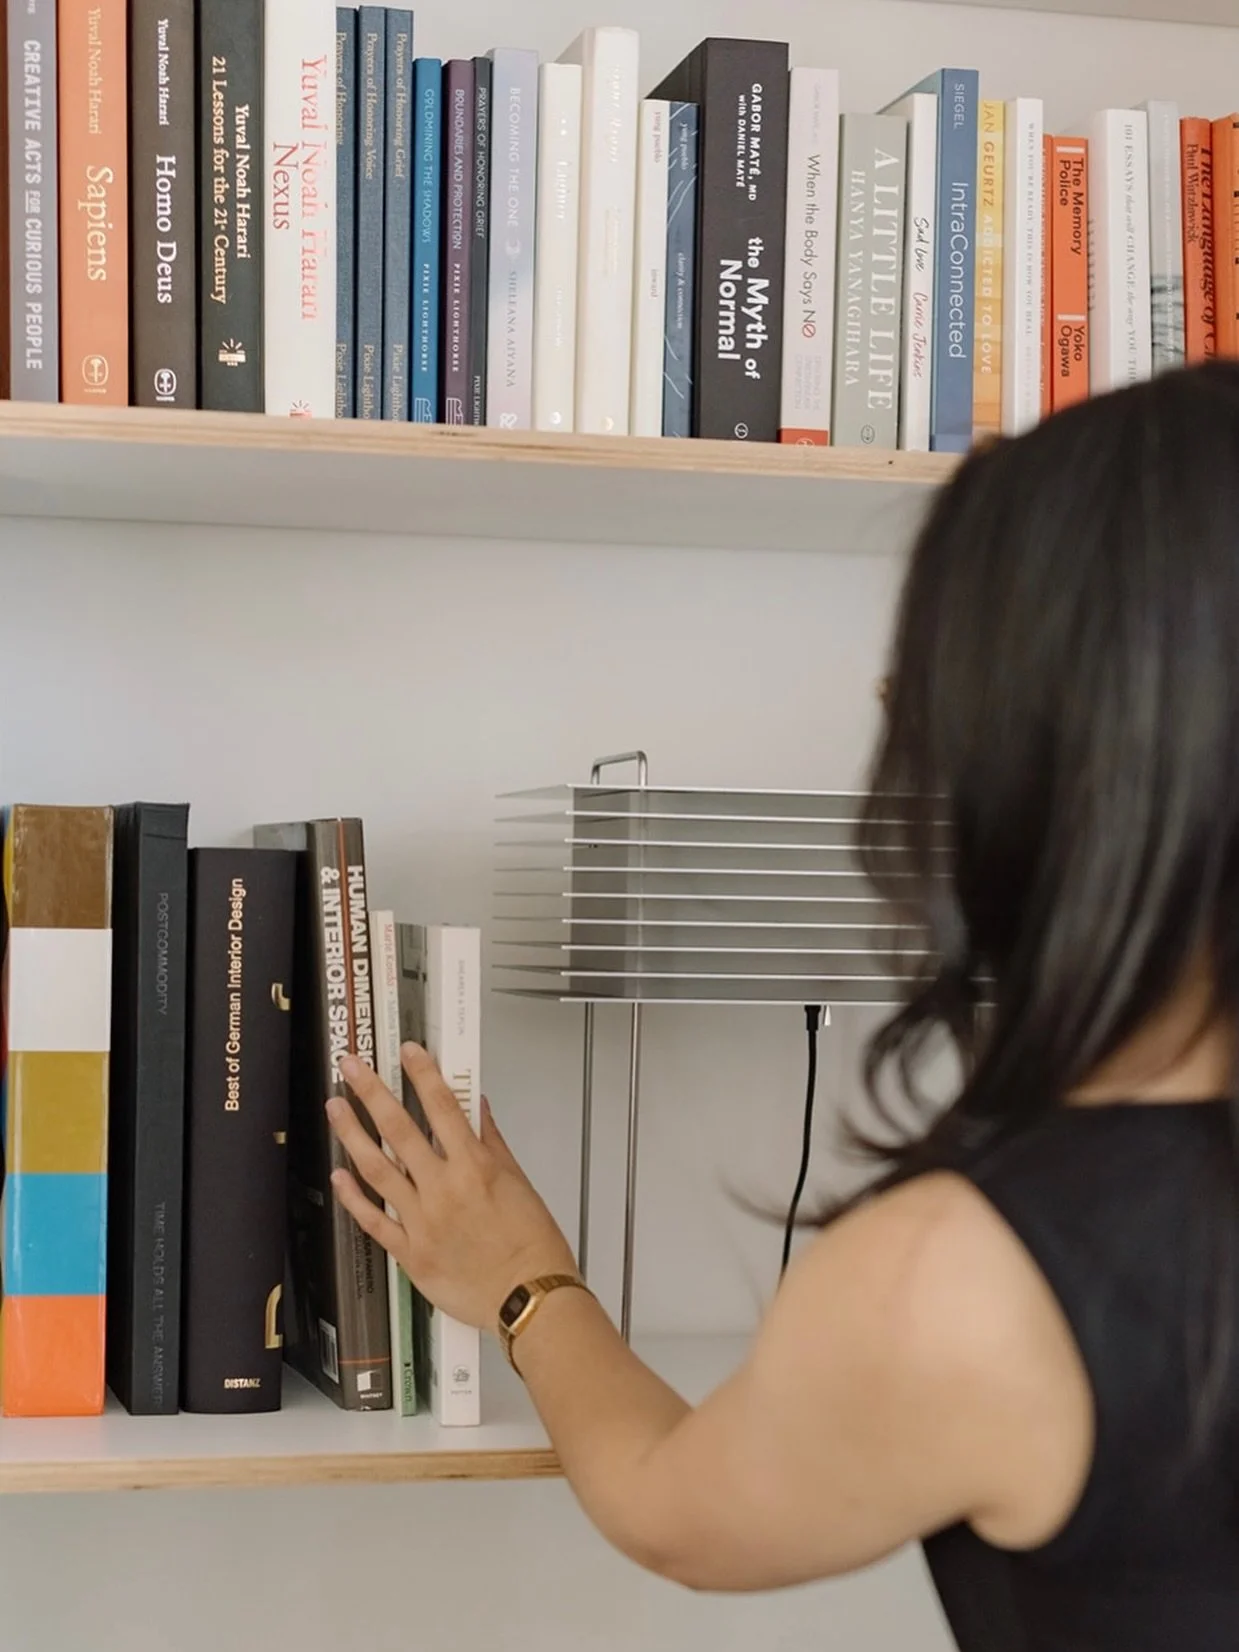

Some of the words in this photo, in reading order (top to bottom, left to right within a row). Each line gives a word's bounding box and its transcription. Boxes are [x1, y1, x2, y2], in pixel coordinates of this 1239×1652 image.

[88, 8, 101, 45] Yuval
[157, 19, 169, 51] Yuval
[88, 49, 102, 86] Noah
[157, 53, 169, 85] Noah
[211, 56, 226, 74] 21
[365, 32, 378, 75] Prayers
[395, 33, 408, 75] Prayers
[24, 40, 41, 130] CREATIVE
[302, 54, 328, 130] Yuval
[366, 78, 378, 90] of
[396, 78, 408, 90] of
[738, 94, 747, 116] with
[88, 89, 103, 134] Harari
[158, 87, 170, 126] Harari
[212, 80, 227, 145] Lessons
[235, 104, 251, 150] Yuval
[364, 92, 377, 146] Honoring
[394, 92, 407, 146] Honoring
[423, 89, 435, 162] GOLDMINING
[454, 89, 465, 154] BOUNDARIES
[476, 87, 486, 131] PRAYERS
[508, 87, 521, 162] BECOMING
[750, 83, 762, 132] GABOR
[953, 83, 965, 130] SIEGEL
[982, 103, 994, 134] JAN
[476, 134, 486, 148] OF
[680, 122, 689, 142] yung
[736, 119, 747, 156] DANIEL
[1124, 124, 1133, 140] 101
[25, 138, 41, 184] ACTS
[213, 149, 230, 173] for
[236, 153, 251, 198] Noah
[365, 150, 377, 180] Voice
[395, 150, 406, 178] Grief
[423, 166, 434, 186] THE
[453, 157, 464, 182] AND
[680, 144, 690, 170] pueblo
[736, 159, 746, 188] MATÉ
[748, 136, 761, 180] MATÉ,
[806, 154, 821, 198] When
[874, 148, 900, 169] A
[983, 140, 995, 208] GEURTZ
[1072, 158, 1084, 187] The
[1124, 145, 1135, 192] ESSAYS
[1186, 144, 1199, 170] Paul
[156, 154, 176, 232] Homo
[213, 177, 230, 204] the
[272, 142, 299, 230] Nexus
[302, 140, 328, 218] Noah
[476, 152, 486, 206] HONORING
[508, 168, 520, 192] THE
[748, 184, 757, 201] MD
[1060, 160, 1072, 207] Police
[25, 190, 41, 213] FOR
[422, 190, 432, 243] SHADOWS
[452, 184, 464, 250] PROTECTION
[507, 196, 519, 227] ONE
[804, 203, 820, 225] the
[849, 170, 866, 241] HANYA
[1186, 173, 1200, 244] Watzlawick
[78, 165, 114, 281] Sapiens
[236, 202, 252, 259] Harari
[475, 210, 485, 238] GRIEF
[913, 217, 930, 244] Sad
[1070, 192, 1084, 256] Memory
[25, 218, 42, 294] CURIOUS
[210, 234, 229, 304] Century
[676, 252, 686, 277] clarity
[747, 236, 764, 269] the
[800, 229, 819, 267] Body
[870, 184, 899, 316] LITTLE
[914, 248, 928, 272] Love
[949, 180, 970, 358] IntraConnected
[982, 215, 993, 297] ADDICTED
[1126, 236, 1136, 289] CHANGE
[156, 240, 177, 304] Deus
[301, 229, 328, 320] Harari
[422, 264, 430, 294] PIXIE
[453, 264, 461, 294] PIXIE
[678, 278, 686, 287] &
[798, 271, 818, 305] Says
[717, 258, 743, 361] Normal
[740, 278, 770, 350] Myth
[844, 250, 864, 387] YANAGIHARA
[982, 304, 992, 326] TO
[25, 302, 42, 369] PEOPLE
[420, 300, 430, 372] LIGHTHORSE
[452, 300, 460, 372] LIGHTHORSE
[912, 333, 928, 378] Jenkins
[981, 333, 992, 374] LOVE
[1058, 325, 1072, 378] Ogawa
[1074, 325, 1085, 362] Yoko
[1128, 330, 1136, 354] YOU
[363, 344, 375, 372] Pixie
[392, 344, 403, 372] Pixie
[744, 358, 760, 380] of
[867, 328, 895, 410] LIFE
[320, 866, 340, 886] &
[228, 878, 247, 931] Design
[347, 865, 368, 953] HUMAN
[156, 892, 169, 1016] POSTCOMMODITY
[227, 934, 243, 989] Interior
[322, 888, 346, 1000] INTERIOR
[386, 954, 396, 987] Kondo
[226, 992, 242, 1054] German
[225, 1058, 240, 1073] of
[224, 1076, 240, 1112] Best
[154, 1202, 166, 1234] TIME
[152, 1238, 165, 1285] HOLDS
[152, 1288, 164, 1312] ALL
[152, 1314, 164, 1340] THE
[224, 1378, 260, 1388] DISTANZ
[404, 1368, 413, 1402] Crown
